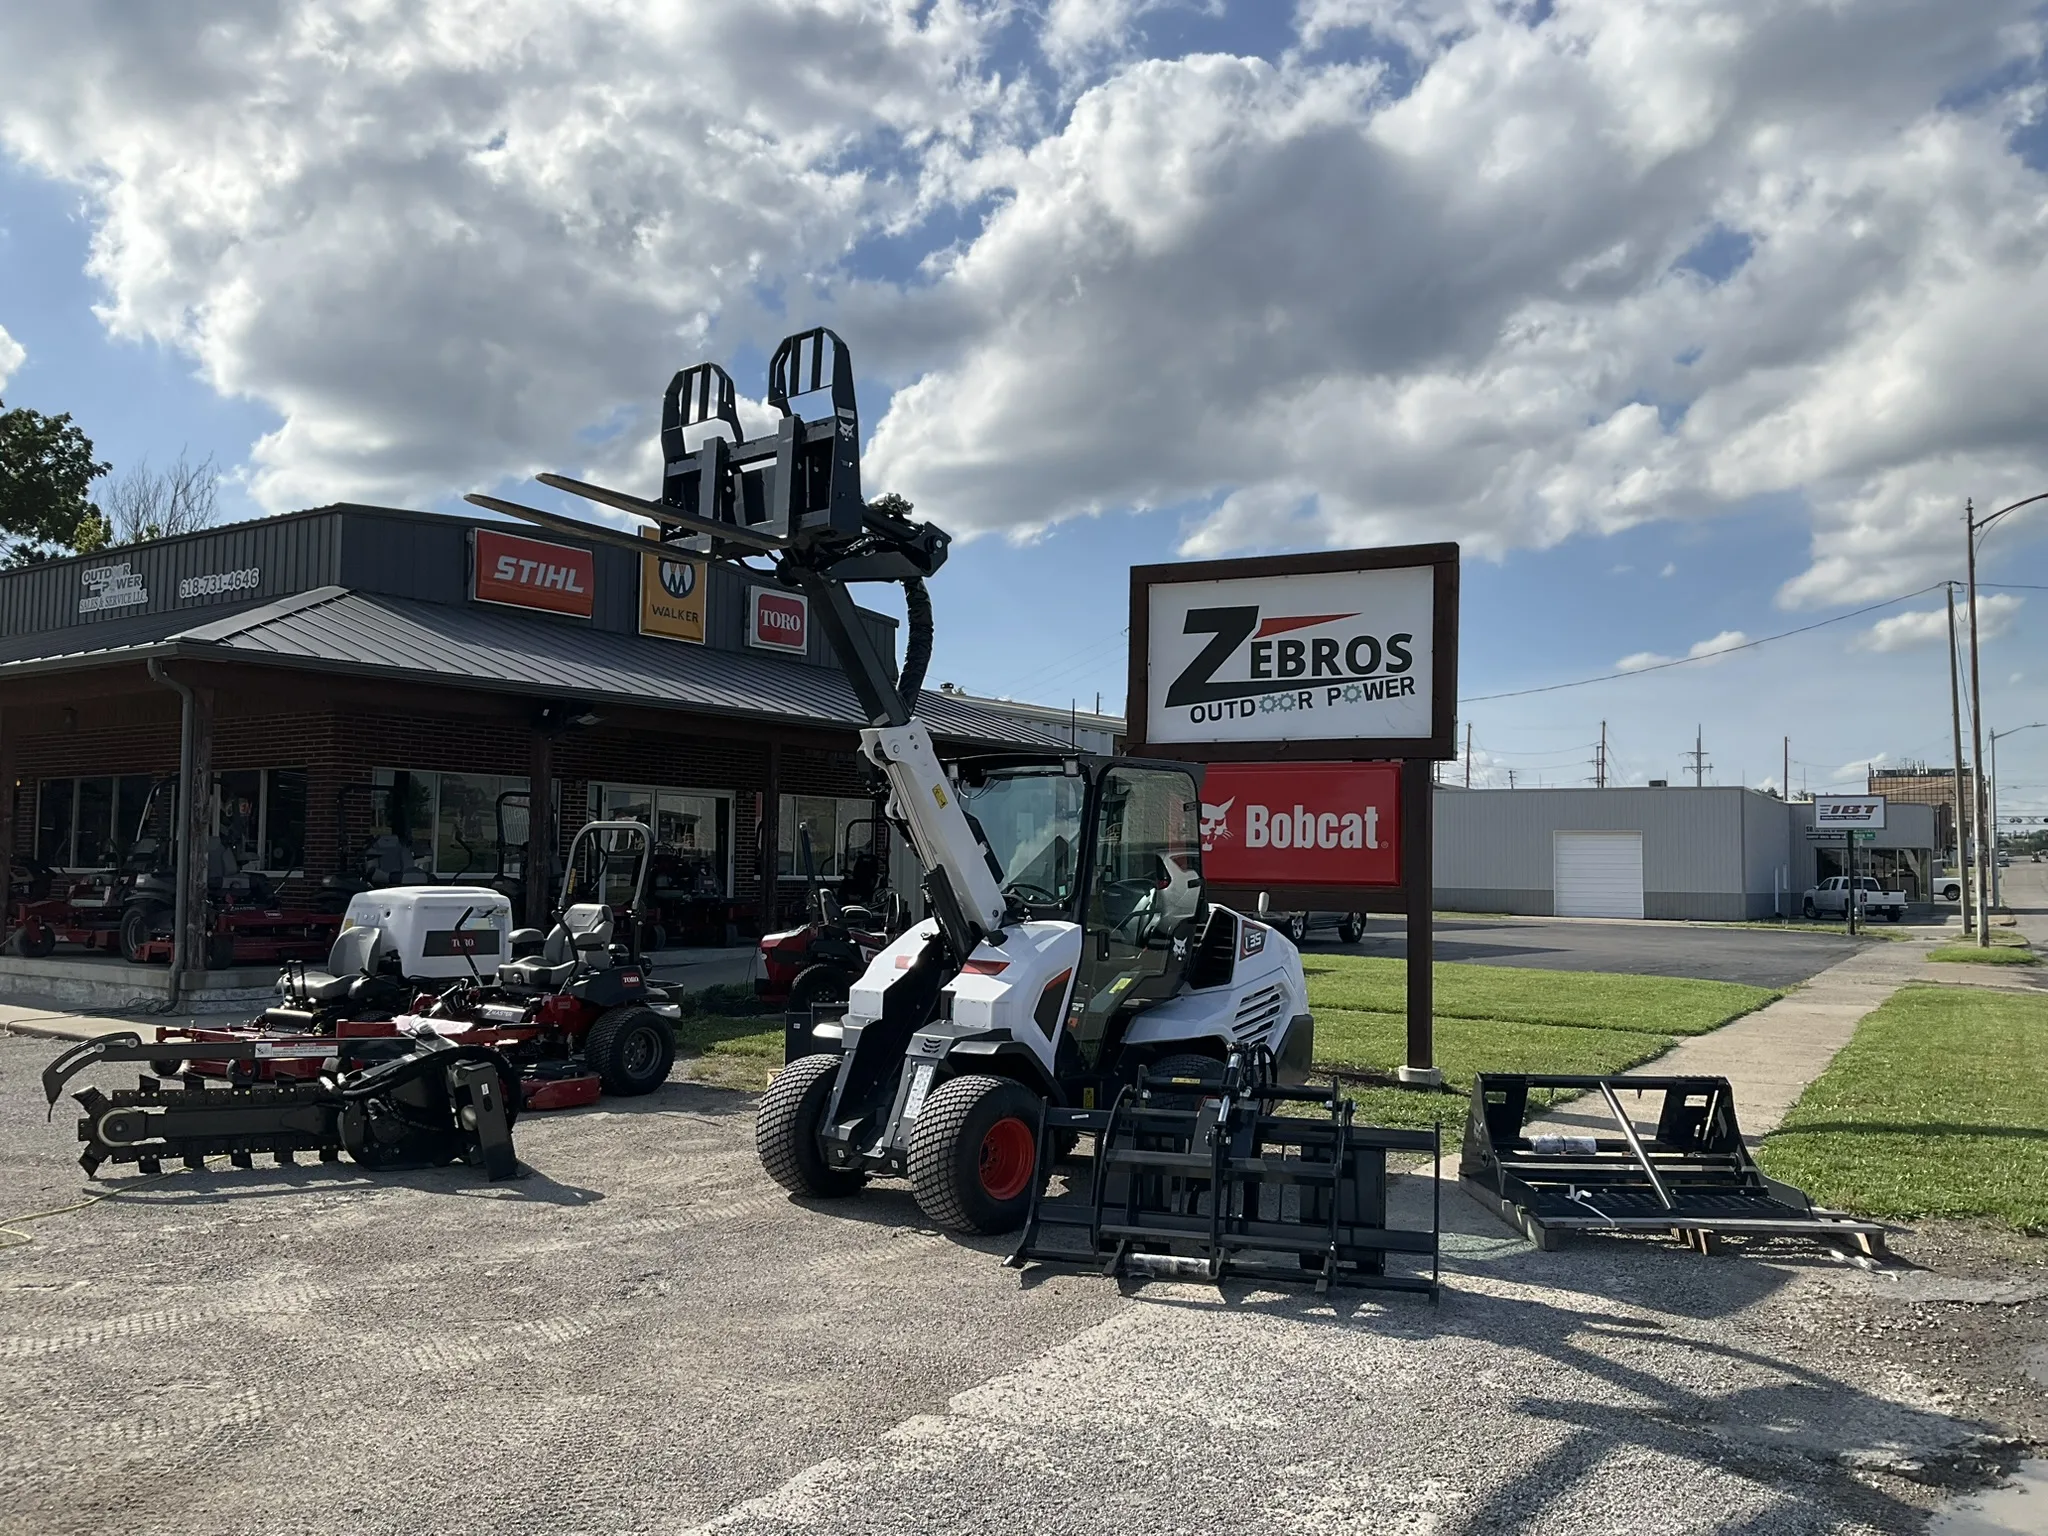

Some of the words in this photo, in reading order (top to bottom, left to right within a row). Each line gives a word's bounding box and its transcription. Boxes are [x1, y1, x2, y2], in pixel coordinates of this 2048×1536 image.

[84, 564, 130, 583] OUTDR
[102, 575, 141, 592] PWER
[180, 569, 259, 597] 618-731-4646
[493, 555, 585, 594] STIHL
[80, 597, 99, 611] SALES
[99, 596, 104, 608] &
[105, 592, 132, 606] SERVICE
[651, 603, 699, 623] WALKER
[760, 608, 801, 631] TORO
[1164, 605, 1414, 708] ZEBROS
[1189, 690, 1314, 723] OUTDOOR
[1326, 675, 1416, 707] POWER
[1831, 804, 1879, 814] IBT
[1245, 804, 1379, 849] Bobcat
